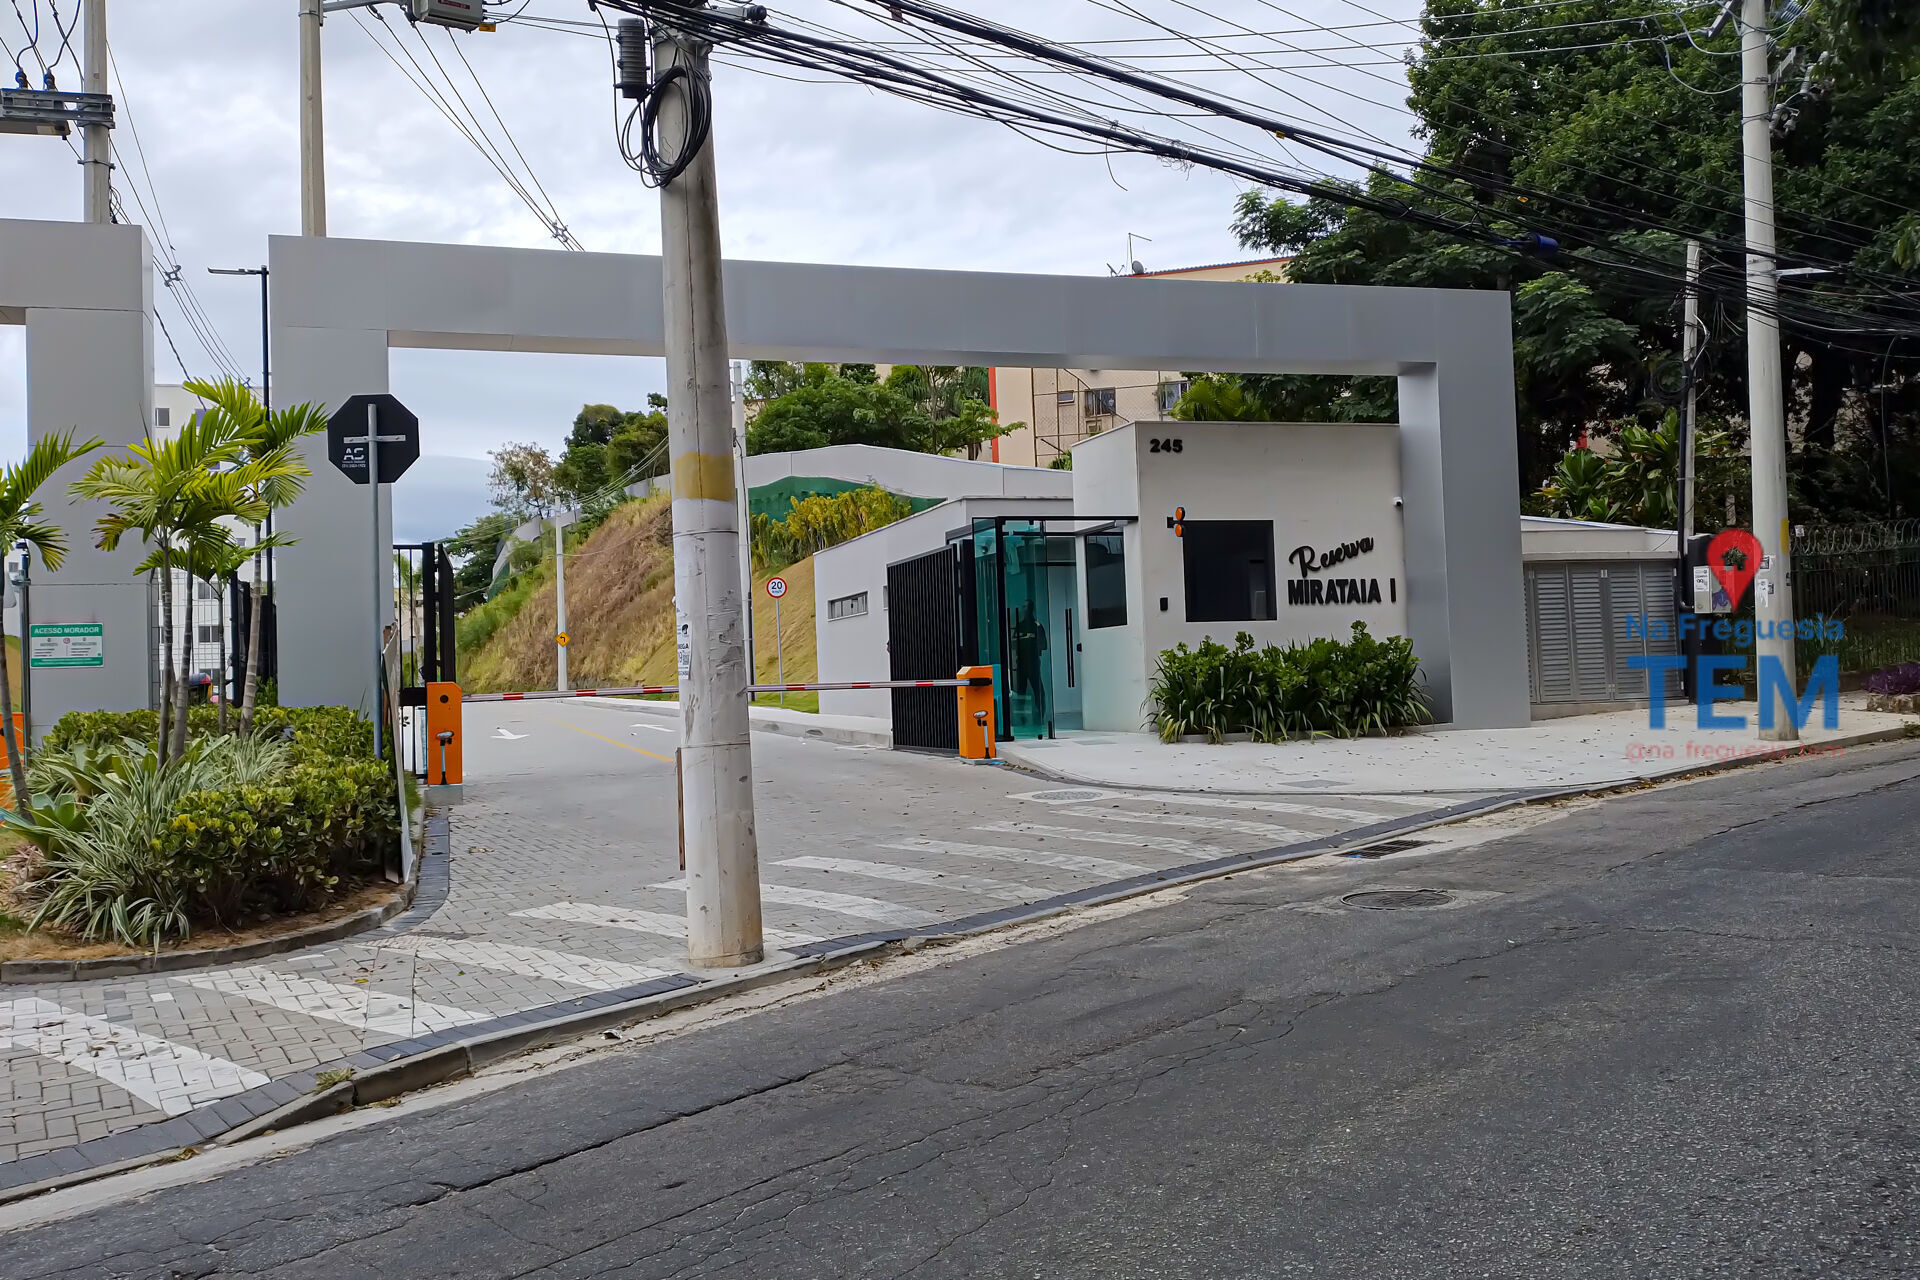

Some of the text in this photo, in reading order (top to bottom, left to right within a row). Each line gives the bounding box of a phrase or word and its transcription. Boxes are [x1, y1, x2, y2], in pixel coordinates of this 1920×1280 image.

[1149, 438, 1183, 453] 245
[343, 447, 365, 460] AS
[1288, 537, 1374, 578] Reserva
[771, 581, 782, 590] 20
[1287, 577, 1397, 605] MIRATAIA I
